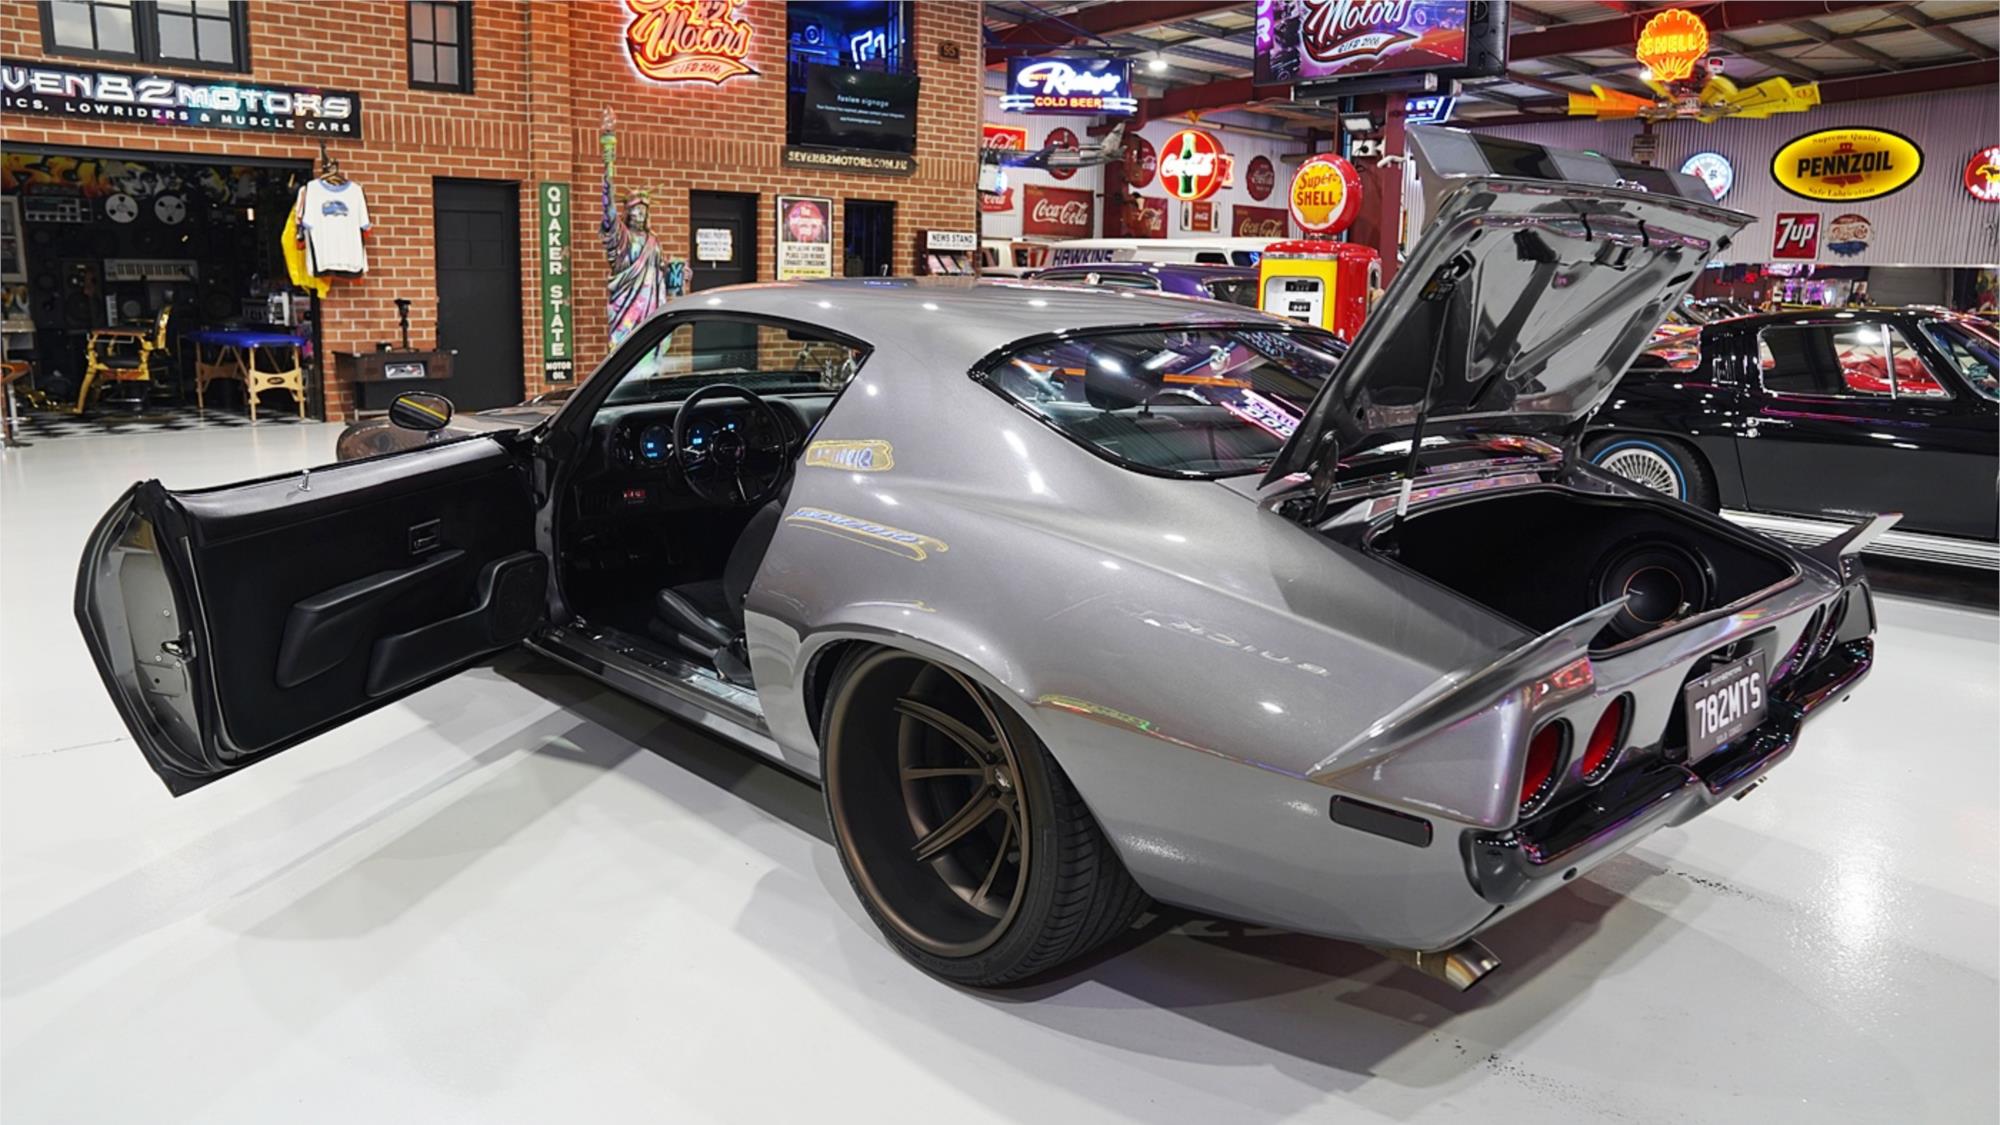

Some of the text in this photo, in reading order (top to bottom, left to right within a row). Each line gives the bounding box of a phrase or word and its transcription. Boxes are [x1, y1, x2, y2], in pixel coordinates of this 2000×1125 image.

[1308, 0, 1403, 44] Motors
[634, 8, 750, 60] Motors
[1644, 34, 1697, 55] SHELL
[1035, 96, 1103, 108] COLD BEER
[65, 102, 190, 121] LOWRIDERS
[200, 113, 211, 123] &
[221, 114, 296, 129] MUSCLE
[305, 121, 351, 132] CARS
[1811, 133, 1881, 144] Supreme Quality
[1796, 150, 1894, 179] PENNZOIL
[1298, 171, 1333, 190] Super
[1296, 190, 1336, 206] SHELL
[931, 233, 974, 244] NEWS STAND
[1776, 217, 1815, 250] 7up
[1052, 248, 1114, 266] HAWKINS
[547, 186, 566, 357] QUAKER STATE
[546, 361, 572, 371] MOTOR
[552, 370, 566, 380] OIL
[1695, 672, 1761, 739] 782MTS
